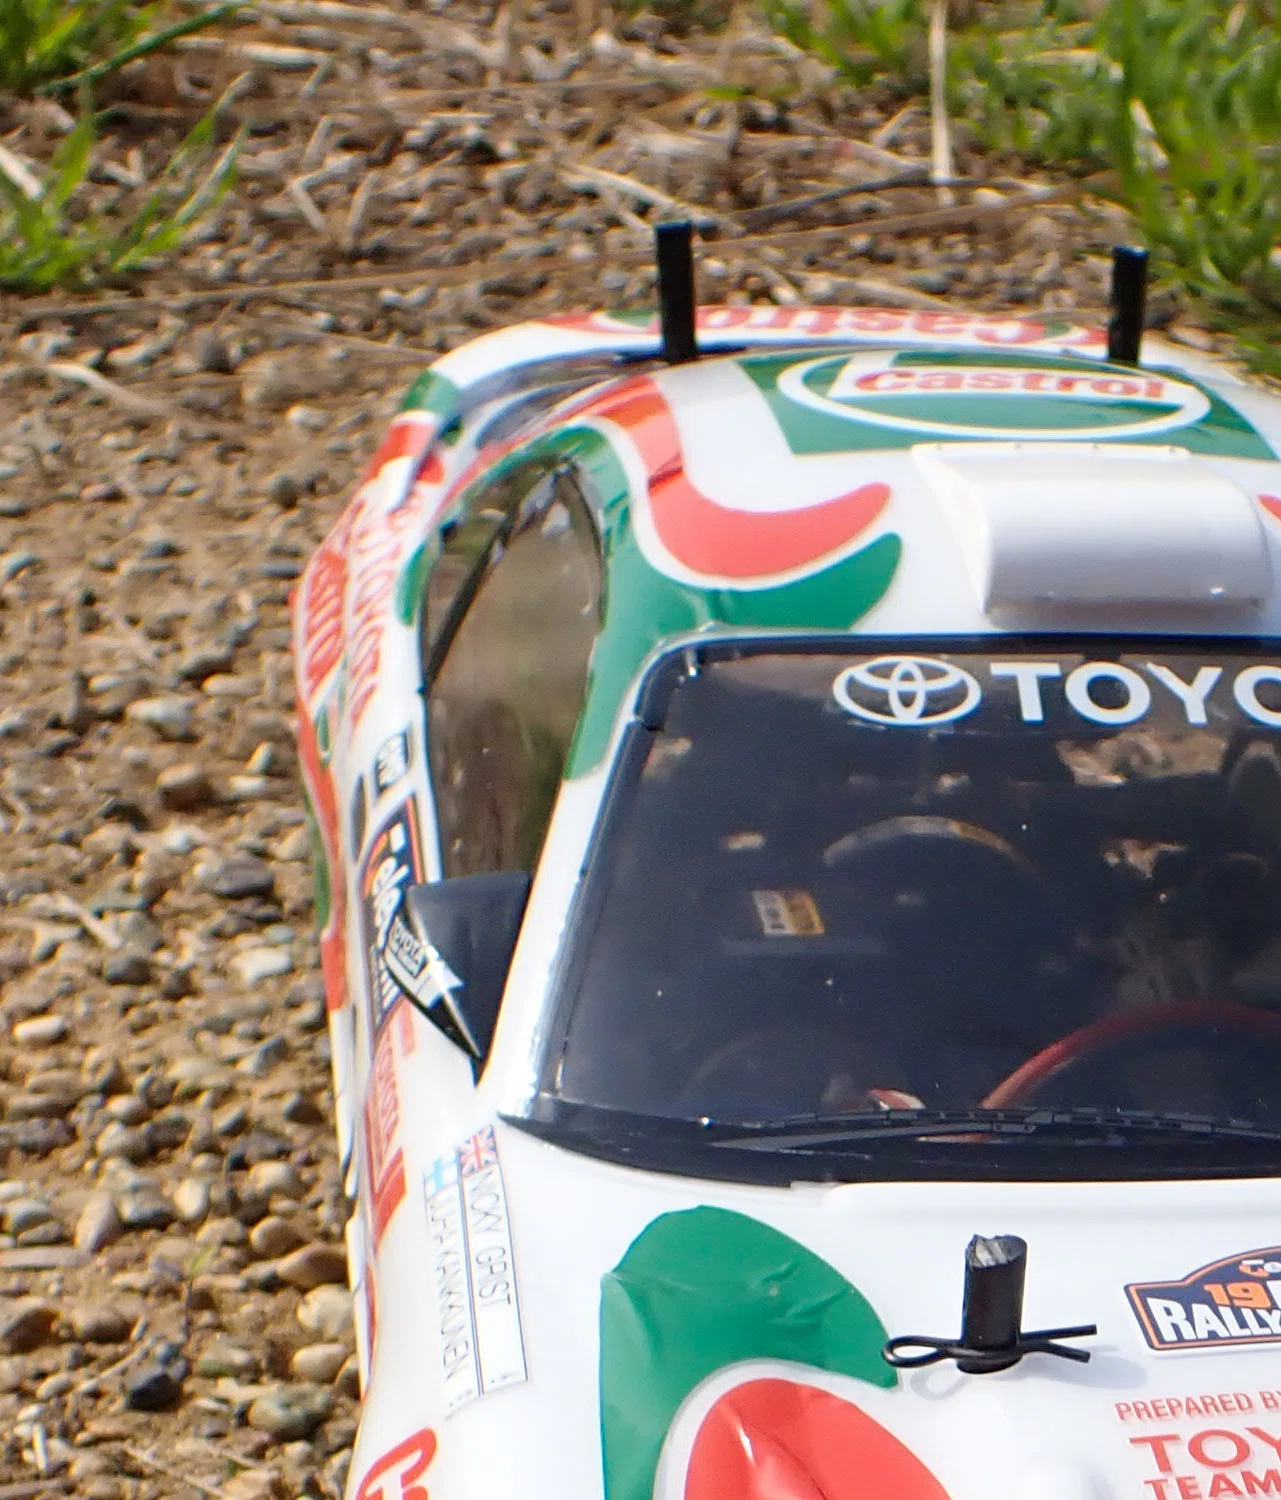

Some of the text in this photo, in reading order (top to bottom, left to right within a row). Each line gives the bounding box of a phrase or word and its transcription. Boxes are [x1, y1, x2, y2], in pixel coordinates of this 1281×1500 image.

[692, 301, 1046, 343] Castro
[855, 369, 1164, 399] Castrol
[474, 1246, 512, 1306] GRIST
[1203, 1280, 1272, 1308] 19
[1115, 1393, 1253, 1422] PREPARED
